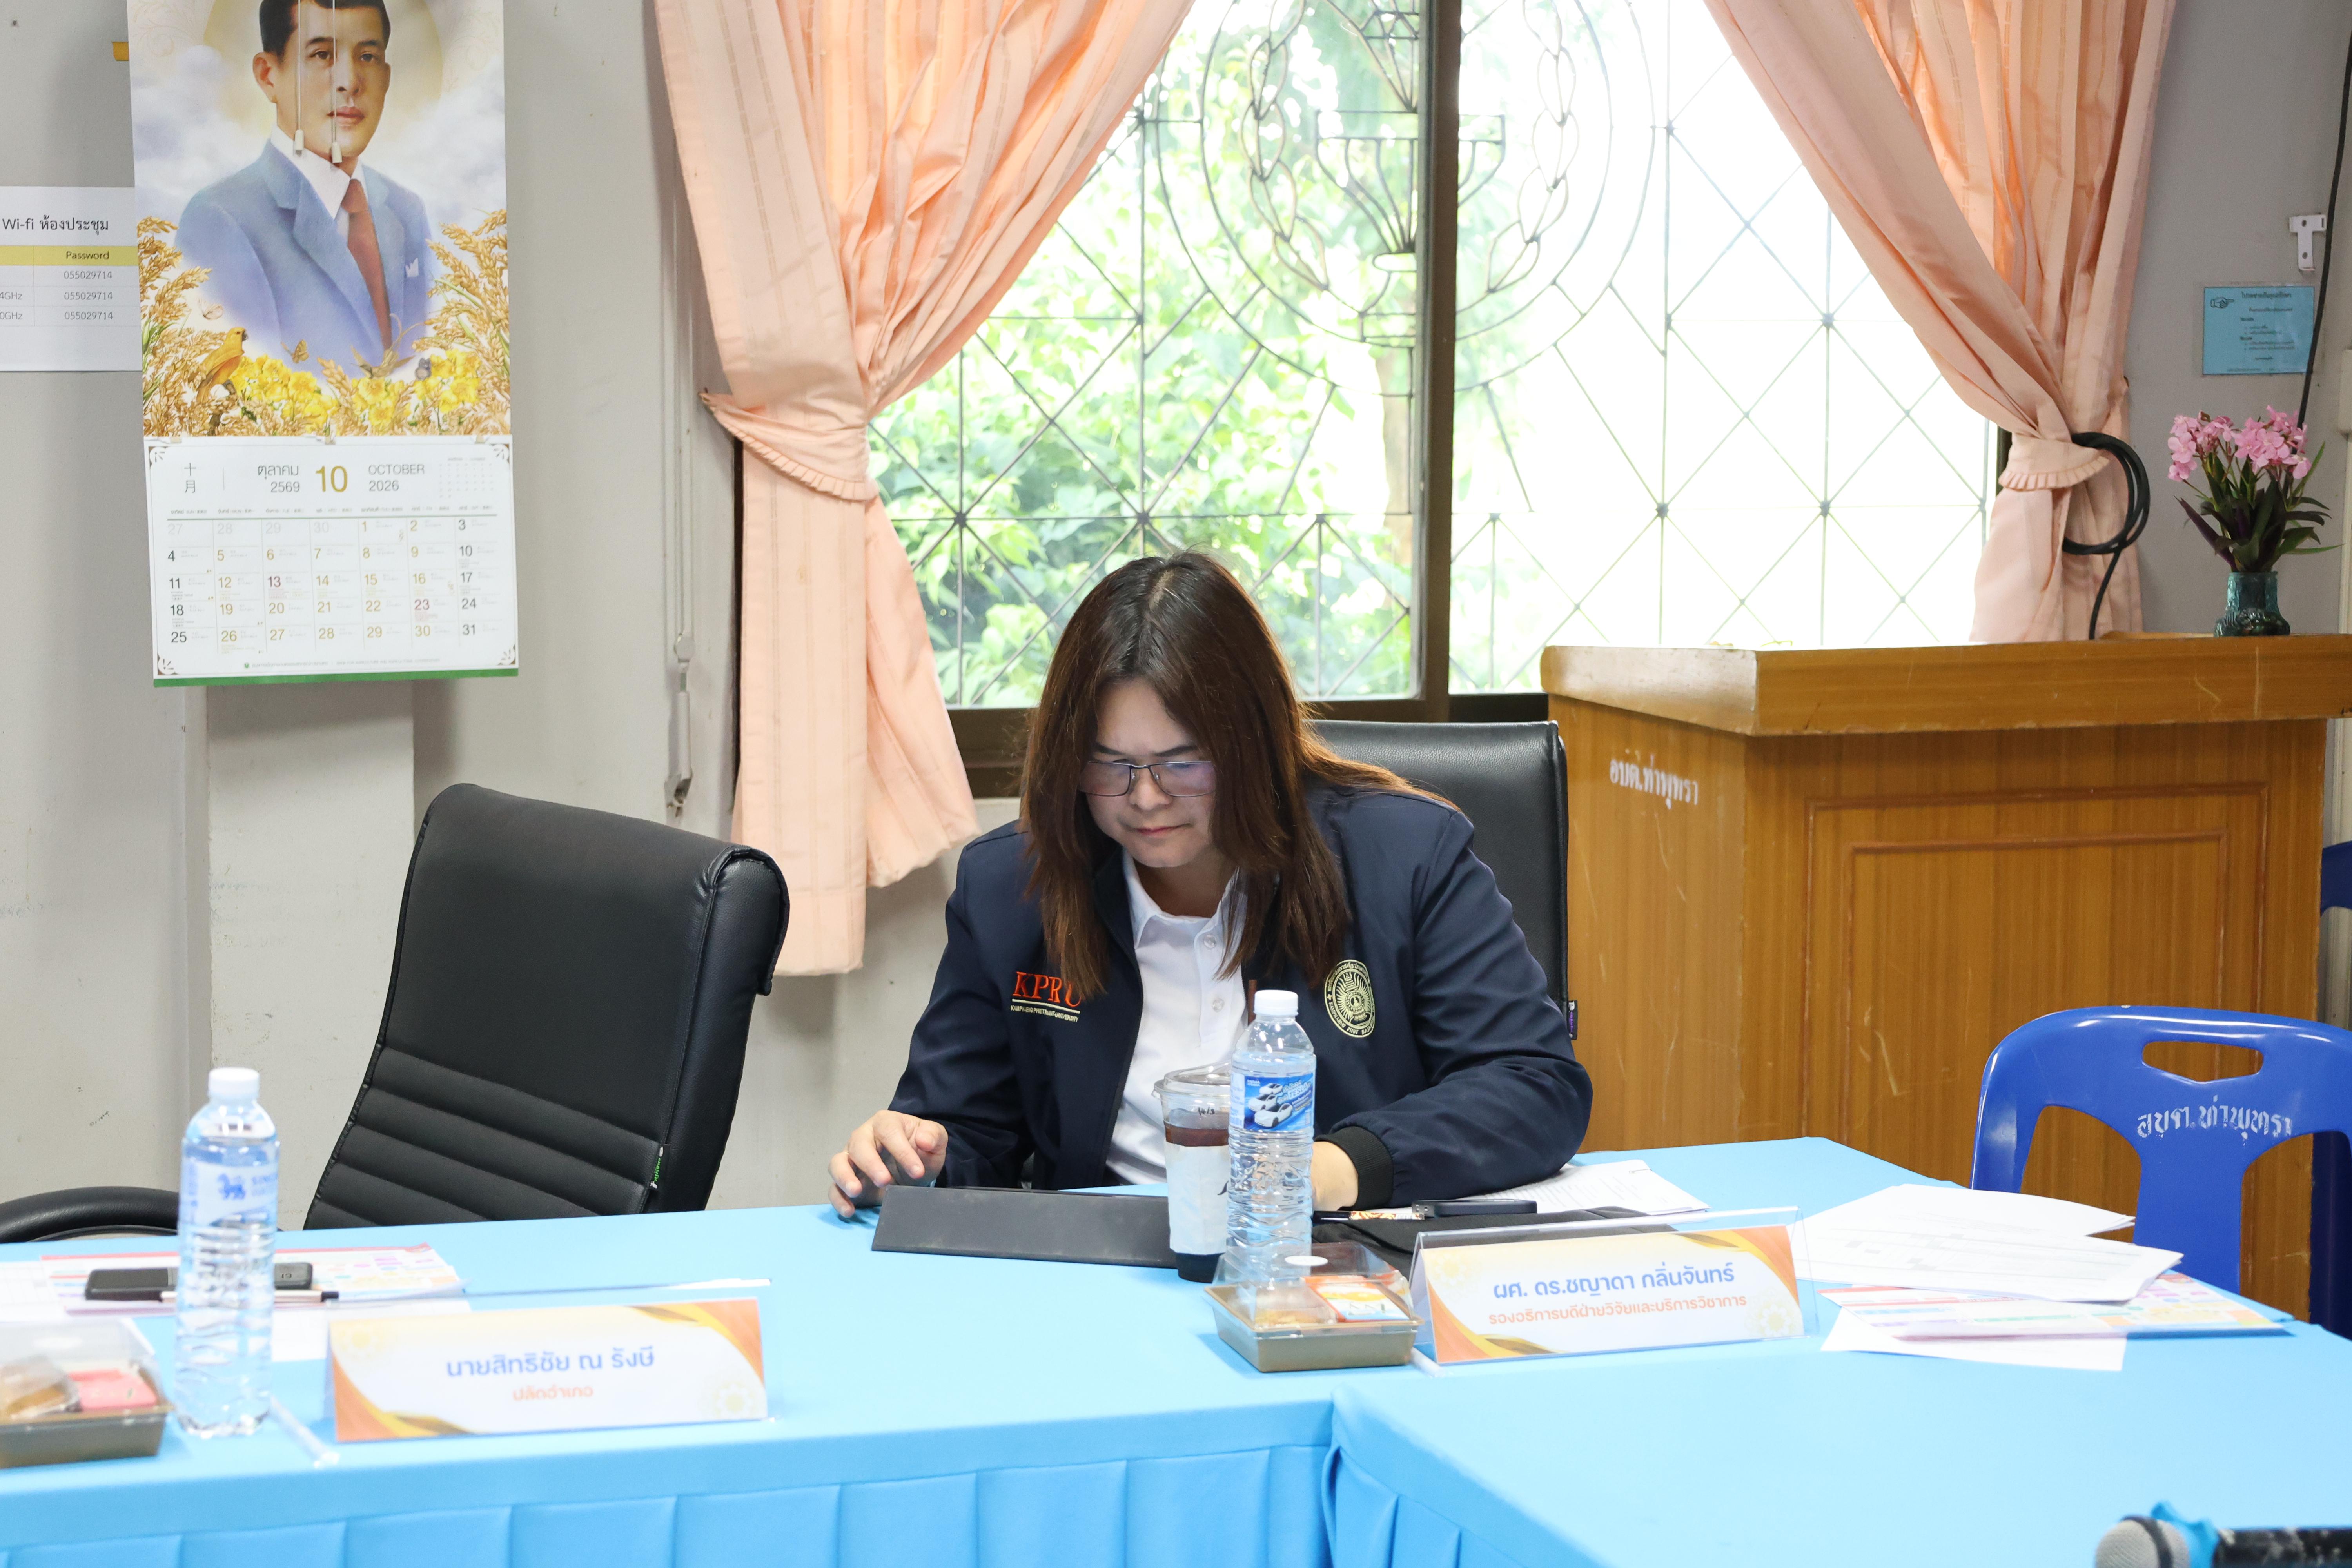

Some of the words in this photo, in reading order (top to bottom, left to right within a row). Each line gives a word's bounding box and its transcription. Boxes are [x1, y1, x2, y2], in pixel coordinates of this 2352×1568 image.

[2, 218, 34, 230] Wi-fi
[39, 214, 109, 235] ห้องประชุม
[66, 250, 110, 260] Password
[64, 270, 112, 279] 055029714
[64, 292, 113, 300] 055029714
[64, 311, 113, 320] 055029714
[184, 463, 196, 476] 十
[258, 465, 299, 479] ตุลาคม
[368, 464, 425, 475] OCTOBER
[316, 465, 348, 492] 10
[368, 480, 399, 492] 2026
[185, 480, 196, 493] 月
[270, 481, 300, 493] 2569
[168, 523, 183, 535] 27
[217, 522, 233, 534] 28
[265, 522, 281, 534] 29
[314, 521, 329, 533] 30
[361, 521, 367, 532] 1
[410, 520, 418, 532] 2
[458, 519, 466, 531] 3
[168, 550, 175, 562] 4
[217, 549, 225, 561] 5
[266, 549, 274, 560] 6
[314, 548, 321, 559] 7
[363, 547, 370, 559] 8
[411, 546, 419, 558] 9
[459, 545, 472, 557] 10
[169, 577, 180, 589] 11
[218, 577, 232, 588] 12
[268, 576, 281, 587] 13
[316, 575, 329, 586] 14
[364, 574, 377, 585] 15
[413, 573, 426, 584] 16
[461, 572, 473, 583] 17
[170, 604, 184, 616] 18
[220, 604, 233, 615] 19
[269, 603, 284, 614] 20
[318, 601, 331, 613] 21
[366, 600, 381, 612] 22
[414, 599, 430, 610] 23
[461, 598, 476, 610] 24
[171, 632, 187, 643] 25
[221, 630, 237, 642] 26
[270, 629, 285, 640] 27
[319, 628, 334, 639] 28
[367, 626, 383, 638] 29
[415, 625, 430, 637] 30
[463, 624, 475, 635] 31
[1494, 1283, 1528, 1298] ผศ.
[1534, 1274, 1635, 1296] ดร.ชญาดา
[1642, 1262, 1735, 1288] กลิ่นจันทร์
[1489, 1295, 1747, 1325] รองอธิการบดีฝ่ายวิจัยและบริการวิชาการ
[446, 1350, 570, 1377] นายสิทธิชัย
[579, 1353, 603, 1370] ณ
